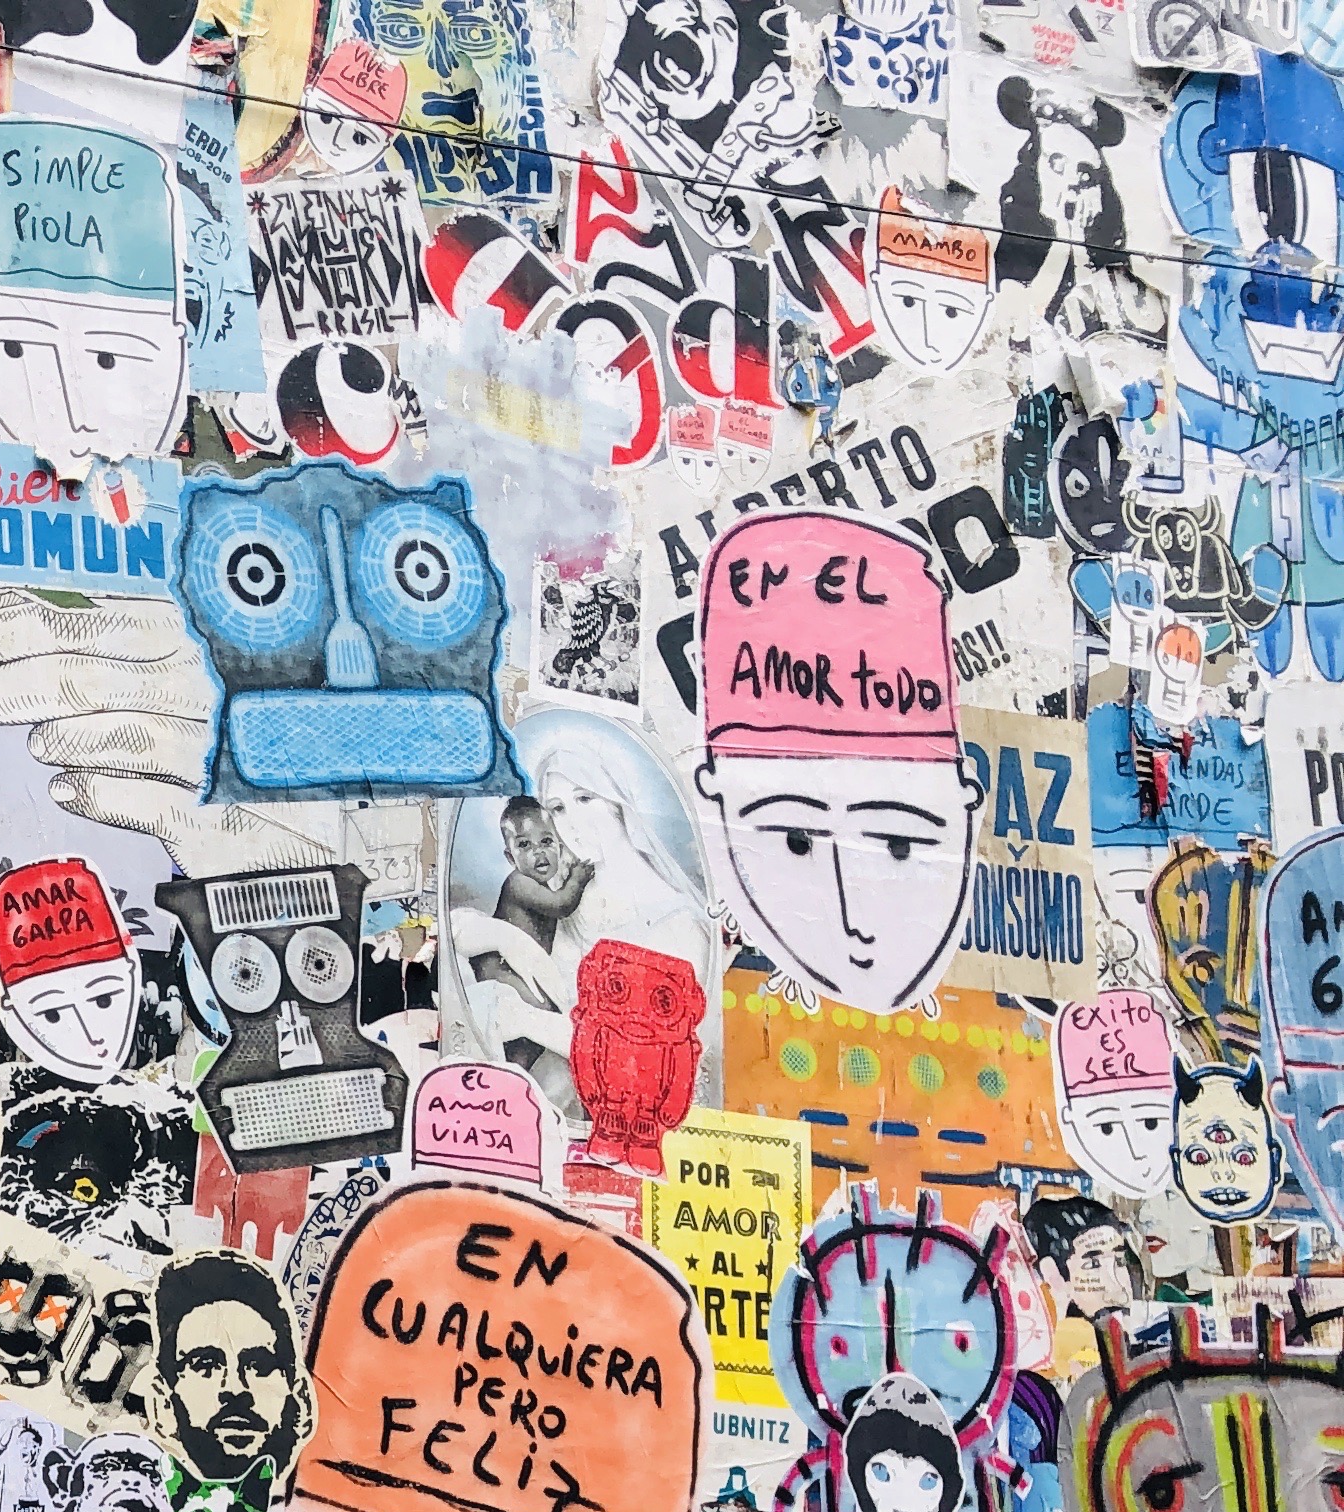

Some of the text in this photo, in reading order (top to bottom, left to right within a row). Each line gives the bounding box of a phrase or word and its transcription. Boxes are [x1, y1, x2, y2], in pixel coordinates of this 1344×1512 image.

[891, 230, 978, 263] MAMBO
[728, 554, 889, 608] EN EL
[730, 640, 845, 708] AMOR
[3, 876, 89, 919] AMAR
[1100, 1027, 1127, 1054] ES
[459, 1067, 489, 1092] EL
[1085, 1054, 1150, 1080] SER
[679, 1158, 732, 1190] POR
[672, 1200, 784, 1242] AMOR
[455, 1220, 569, 1288] EN
[711, 1250, 746, 1279] AL
[453, 1361, 568, 1440] PERO
